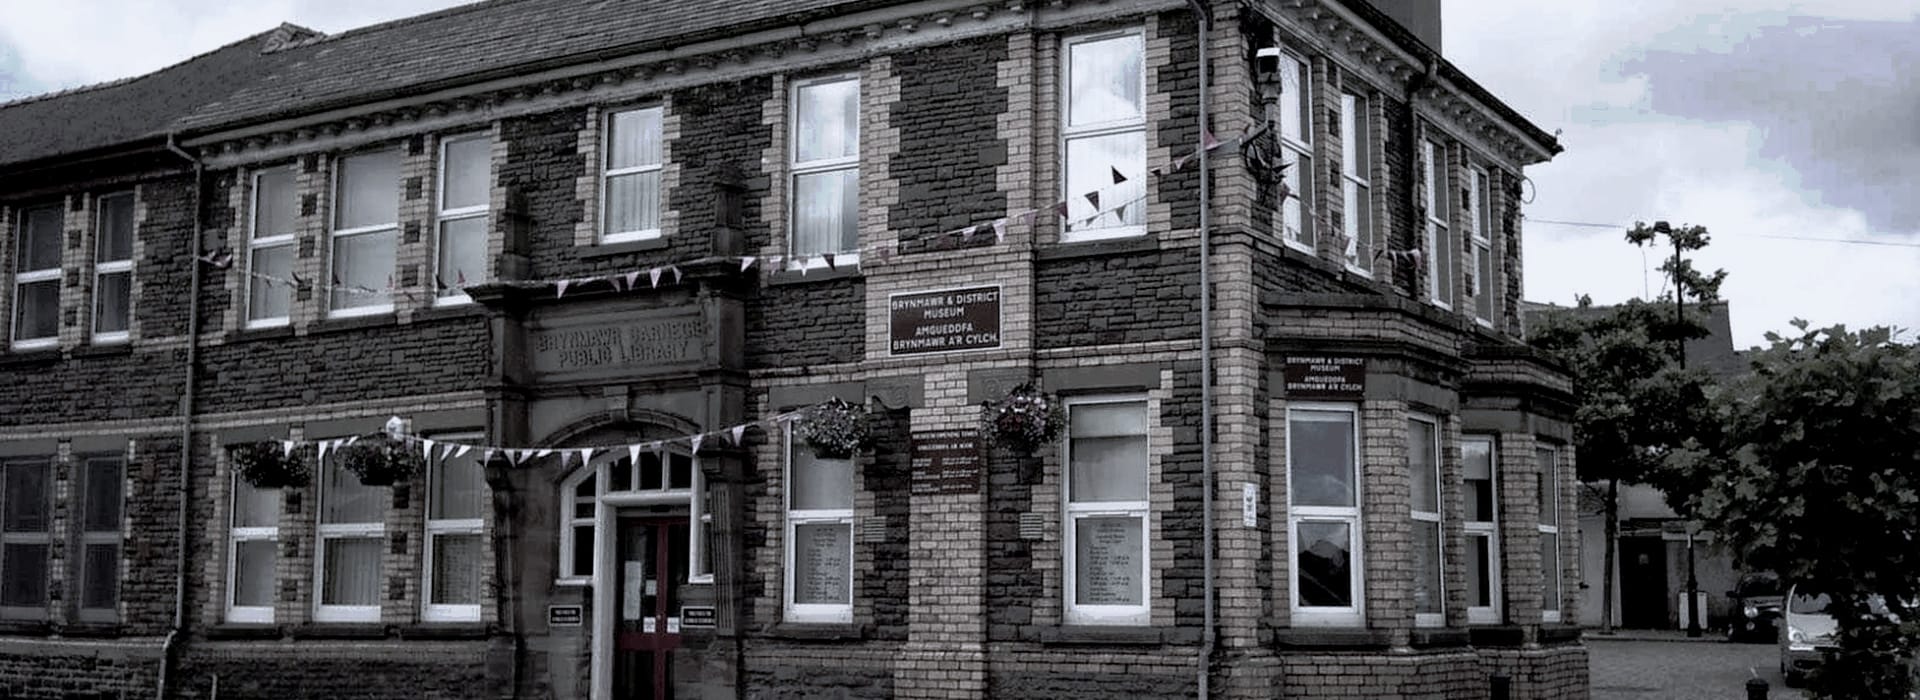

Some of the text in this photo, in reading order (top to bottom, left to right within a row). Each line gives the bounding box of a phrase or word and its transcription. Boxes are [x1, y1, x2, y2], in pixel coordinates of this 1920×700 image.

[892, 291, 998, 311] BRYNMAWR & DISTRICT
[923, 306, 965, 319] MUSEUM
[915, 322, 974, 337] AMGUEDDFA
[893, 339, 945, 351] BRYNMAWR
[1287, 382, 1326, 390] BRYNMAWR
